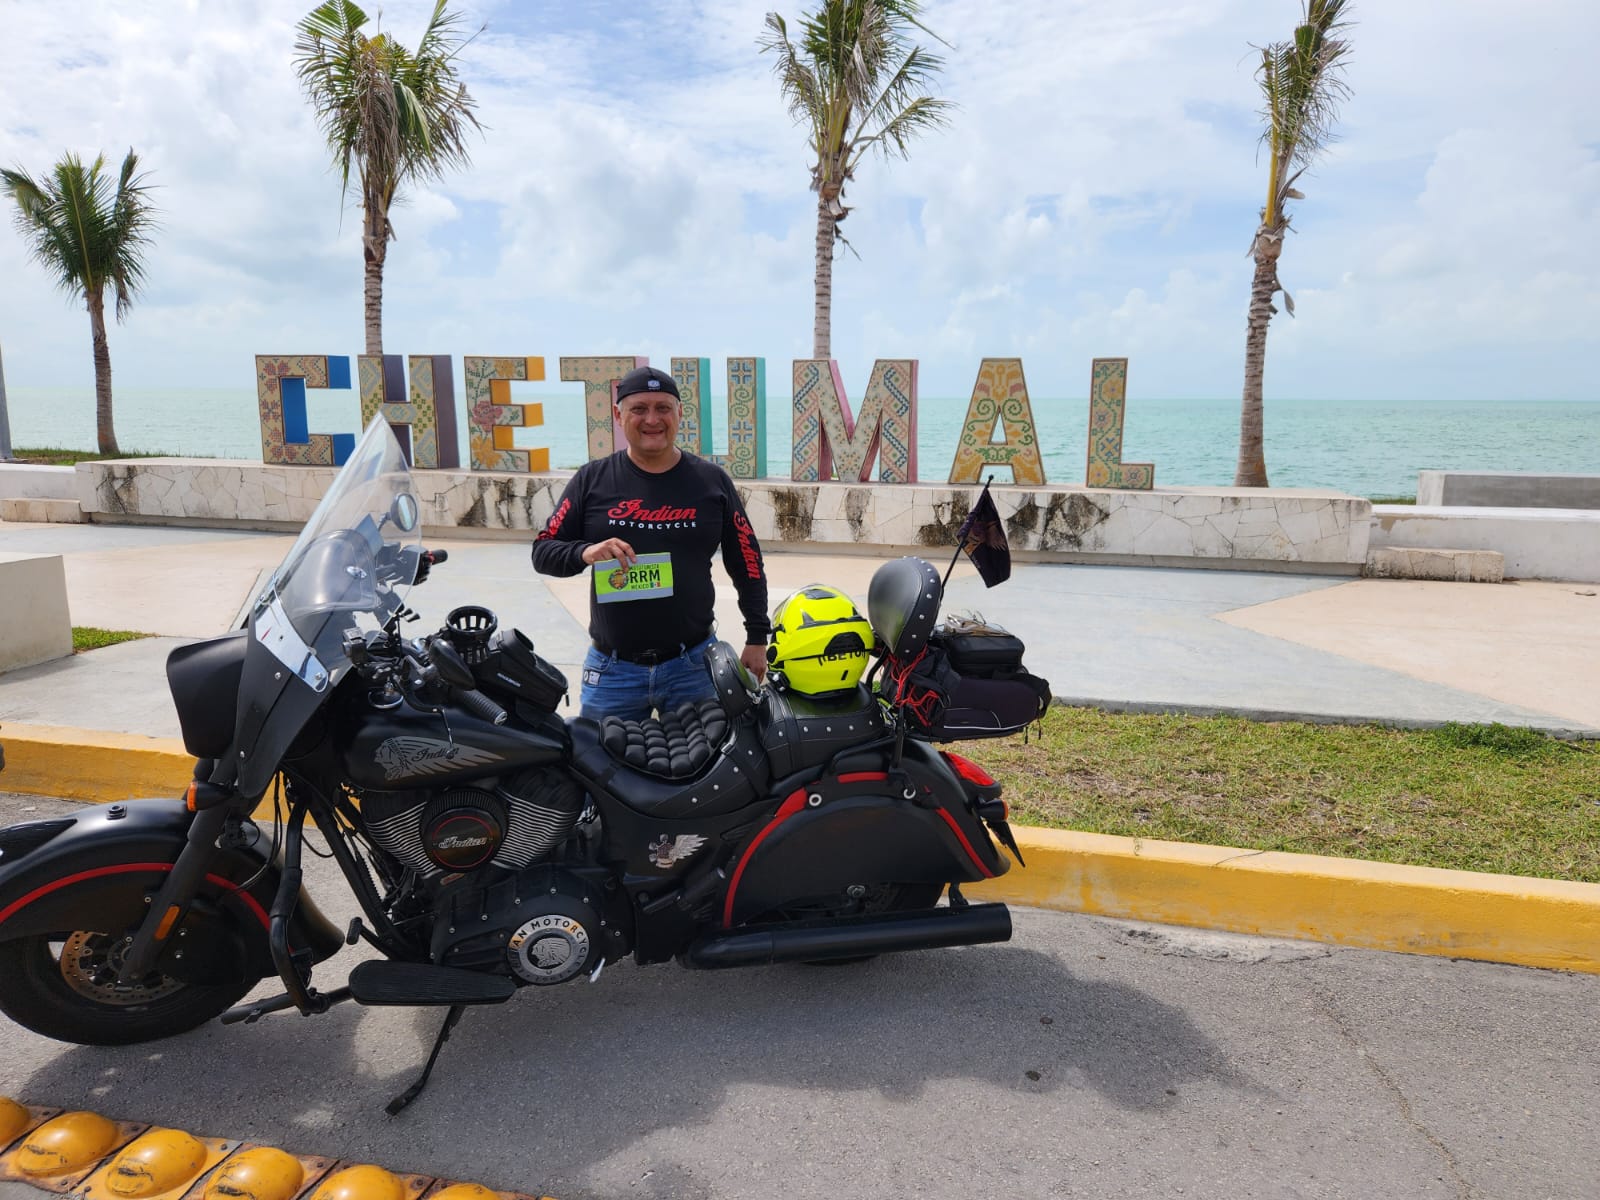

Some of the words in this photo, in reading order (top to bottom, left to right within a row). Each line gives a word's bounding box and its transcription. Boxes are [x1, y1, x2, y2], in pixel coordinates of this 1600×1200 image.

[255, 354, 1155, 489] CHETUMAL
[607, 499, 697, 521] Indian
[608, 519, 697, 530] MOTORCYCLE
[733, 511, 761, 580] Indian
[630, 569, 660, 583] RRM
[411, 747, 460, 762] Indin
[438, 836, 488, 849] Indian
